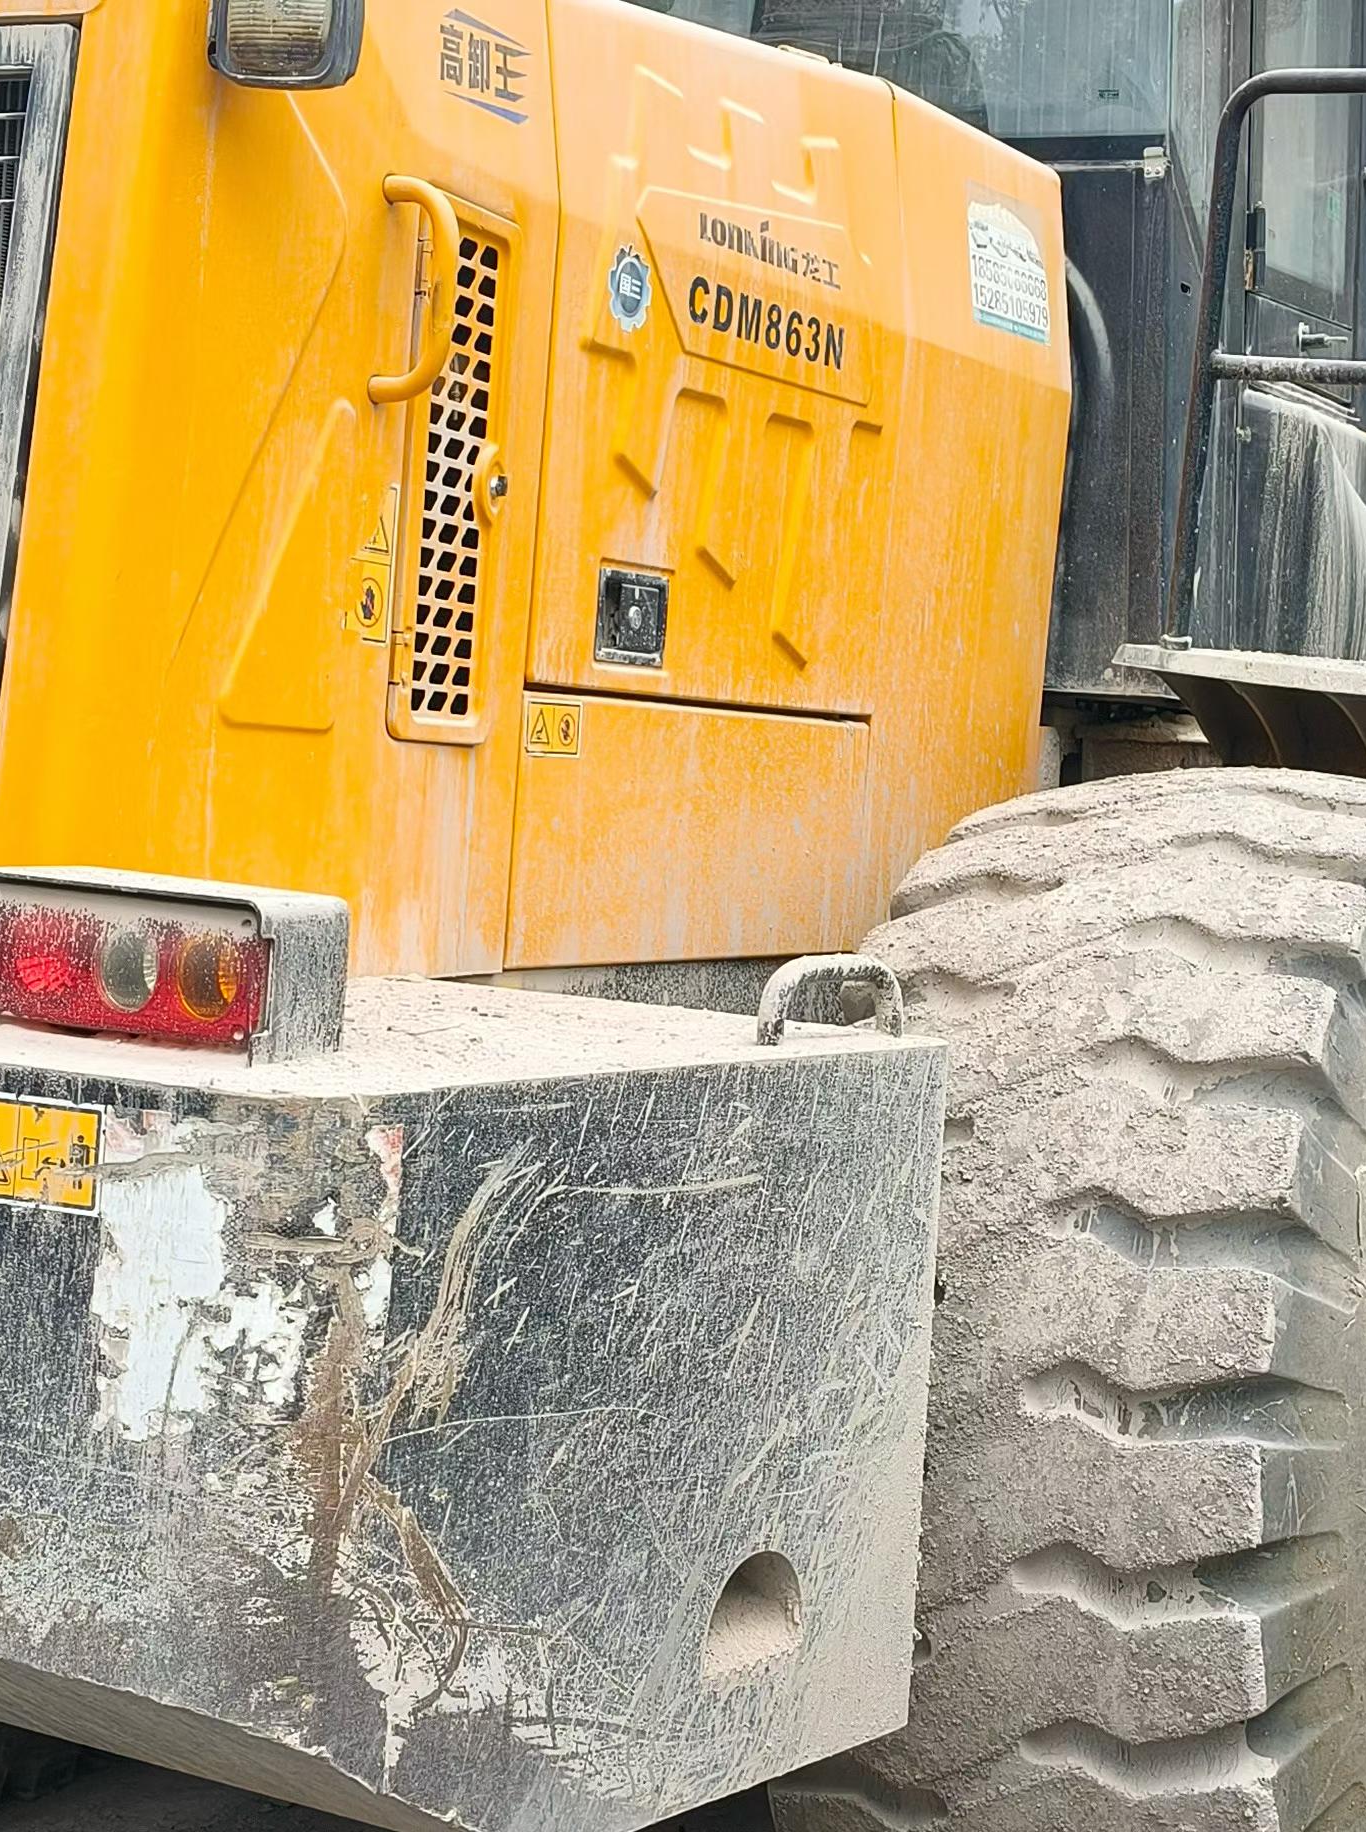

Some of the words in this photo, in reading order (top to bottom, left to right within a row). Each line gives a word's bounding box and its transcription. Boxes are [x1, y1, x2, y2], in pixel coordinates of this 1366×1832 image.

[439, 23, 532, 103] 高卸王
[801, 251, 842, 290] 龙工
[688, 276, 845, 370] CDM863N
